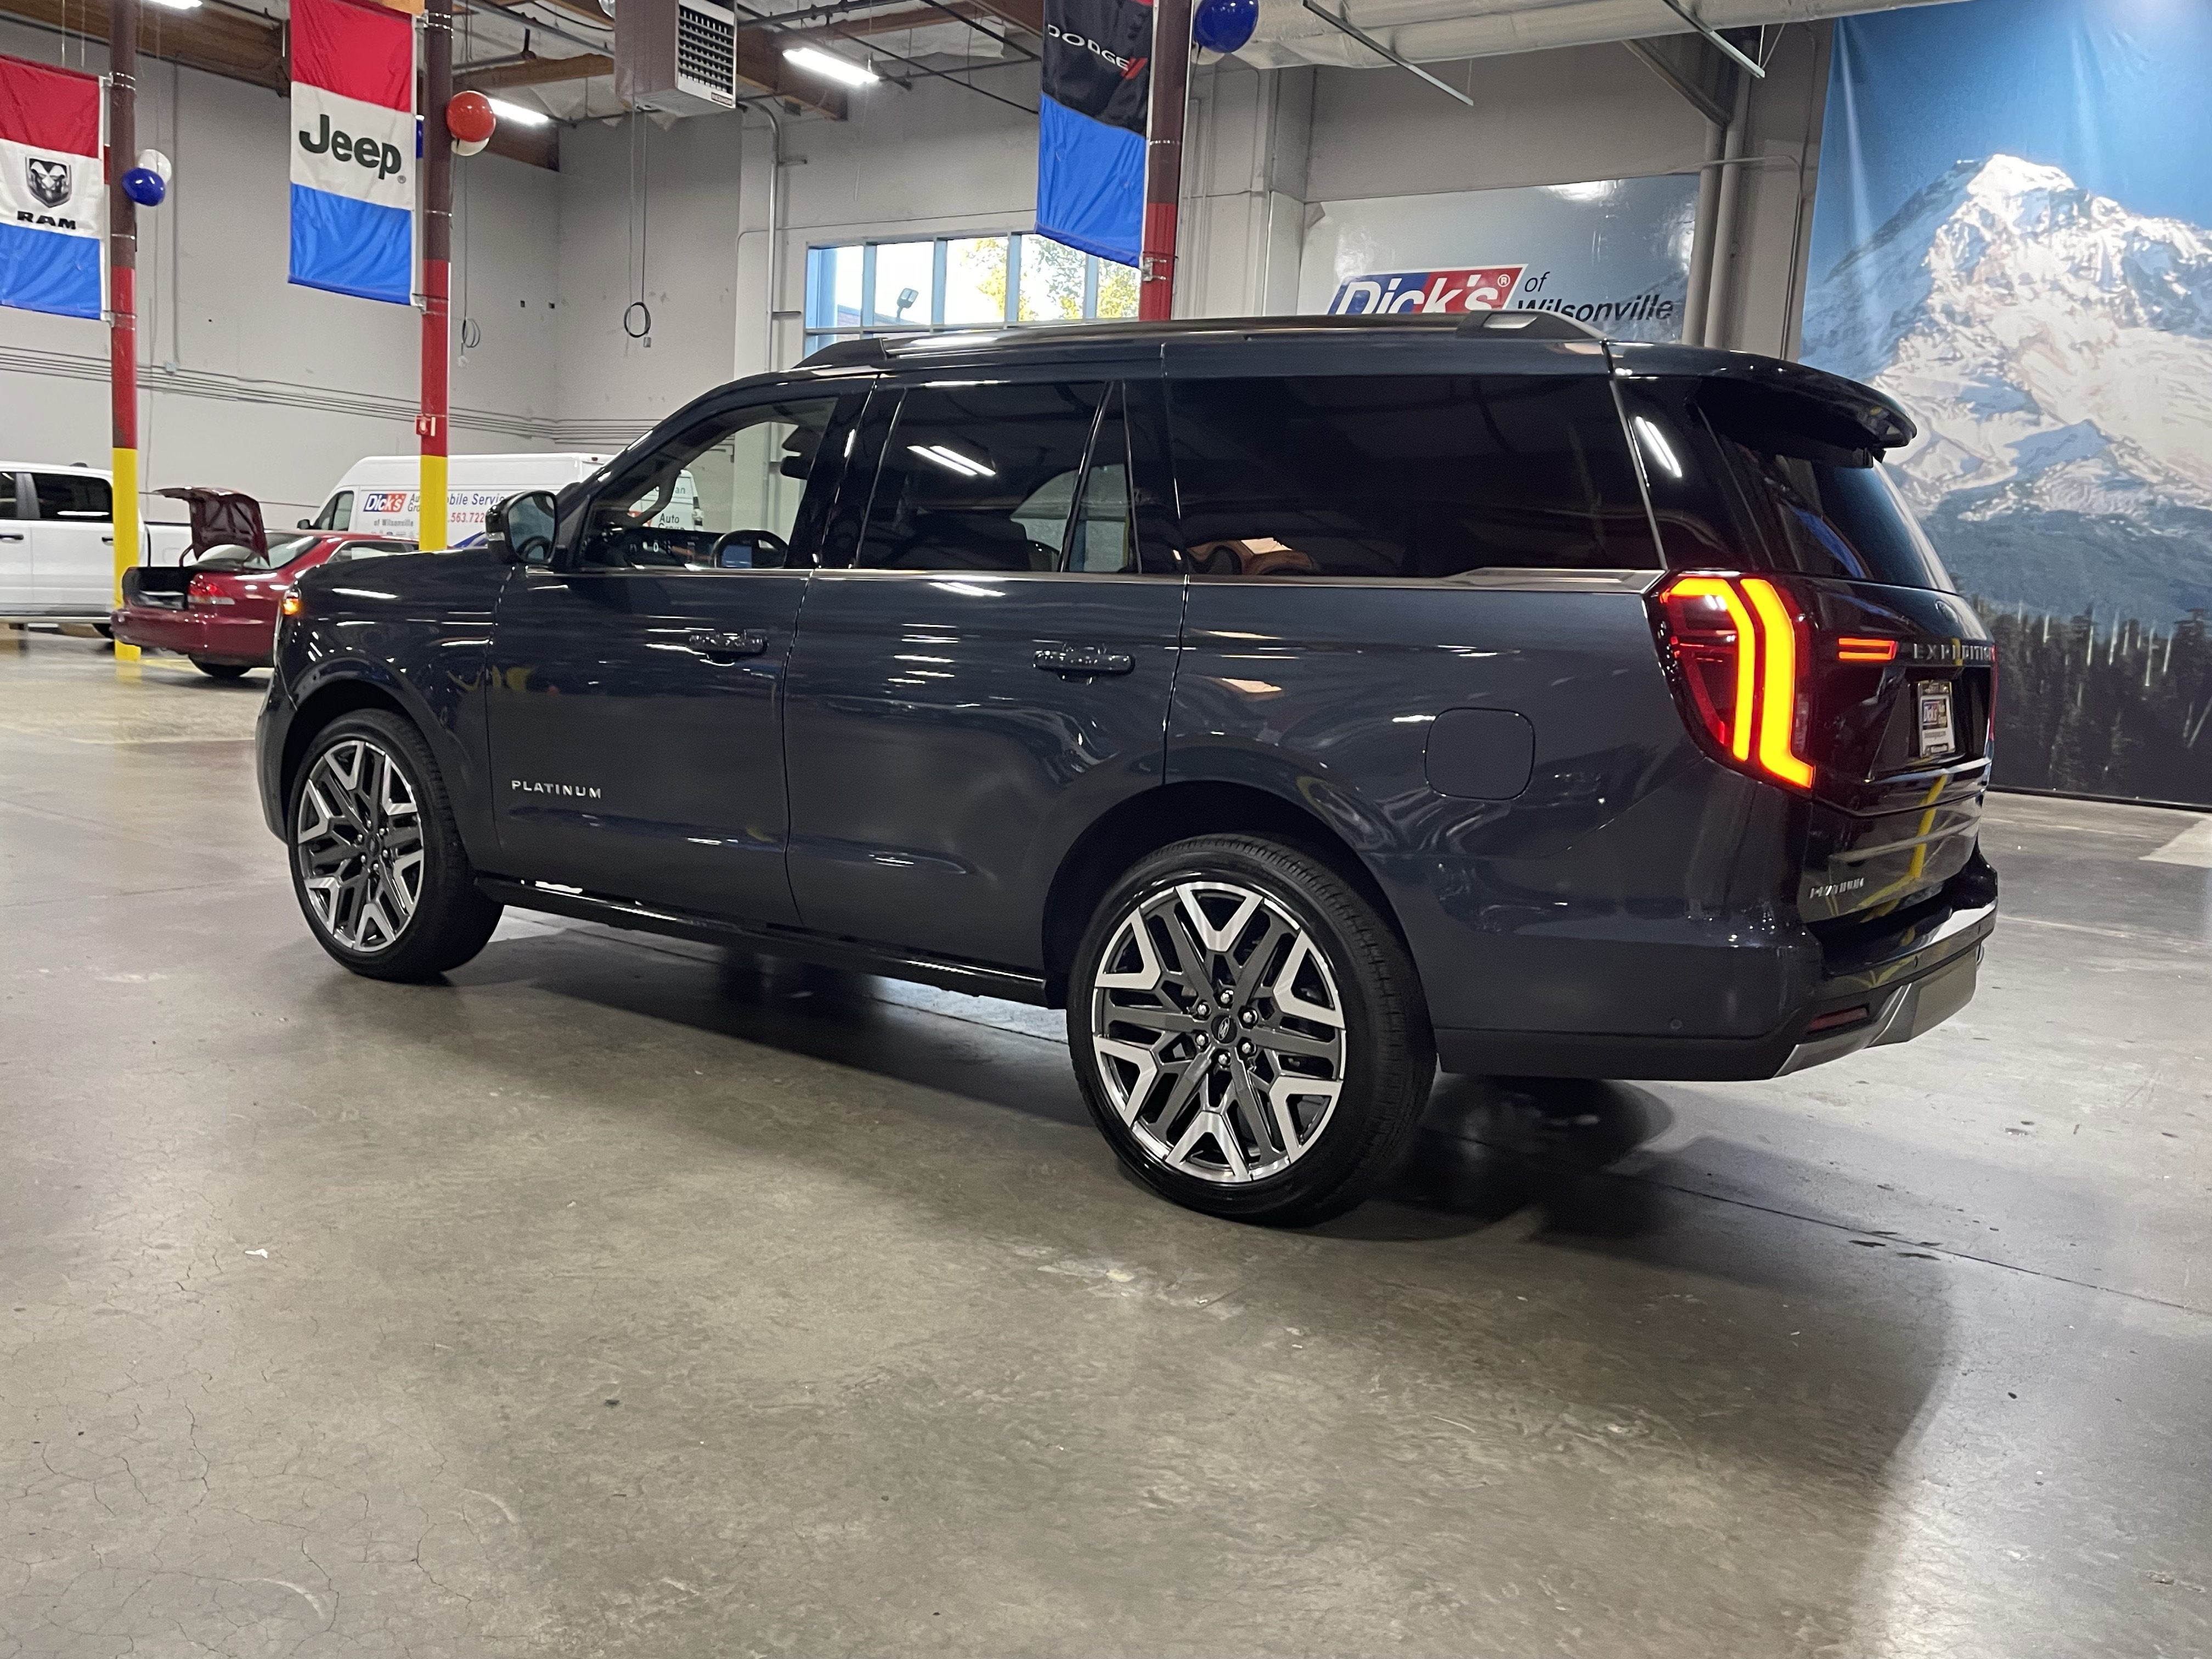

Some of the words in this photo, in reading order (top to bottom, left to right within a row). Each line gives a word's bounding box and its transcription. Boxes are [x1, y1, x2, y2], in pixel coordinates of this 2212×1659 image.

[1048, 24, 1130, 71] DODGE
[299, 114, 402, 180] Jeep
[17, 210, 76, 230] RAM
[1524, 271, 1550, 292] of
[365, 494, 404, 511] Dick's
[472, 493, 505, 505] Servic
[659, 513, 680, 523] Auto
[511, 780, 601, 799] PLATINUM
